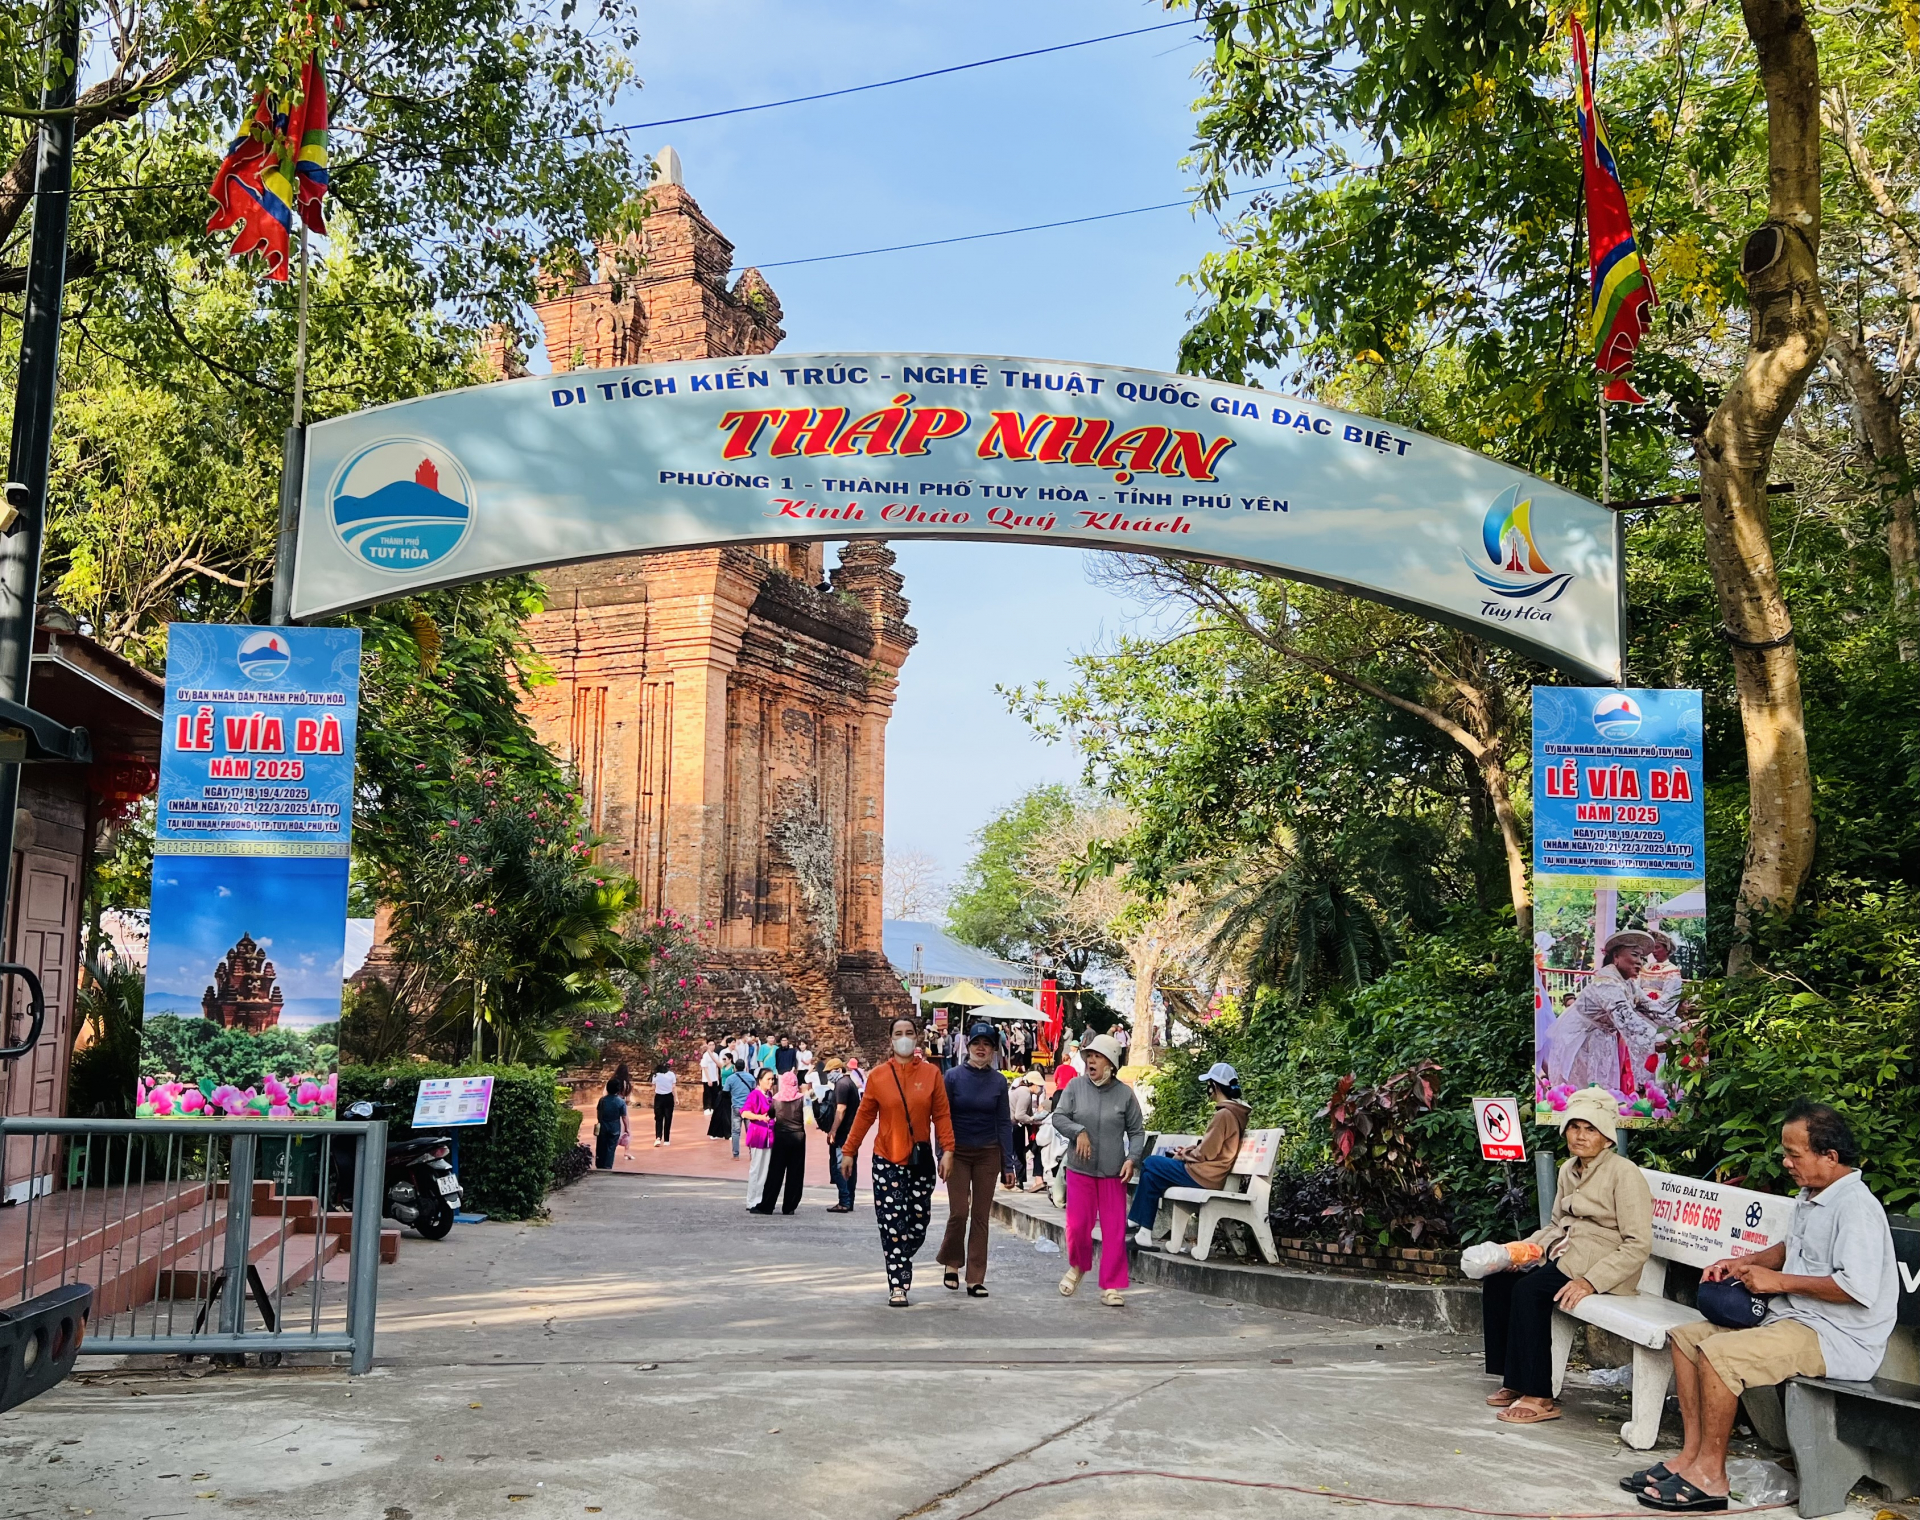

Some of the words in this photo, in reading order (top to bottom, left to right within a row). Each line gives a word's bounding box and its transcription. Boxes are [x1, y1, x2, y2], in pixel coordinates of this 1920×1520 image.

[551, 386, 587, 407] DI
[597, 377, 677, 401] TÍCH
[691, 365, 770, 392] KIẾN
[780, 363, 868, 385] TRÚC
[903, 364, 988, 388] NGHỆ
[1000, 371, 1104, 396] THUẬT
[1116, 383, 1200, 408] QUỐC
[1210, 397, 1260, 420] GIA
[1272, 408, 1332, 435] ĐẶC
[1343, 424, 1412, 456] BIỆT
[718, 393, 971, 460] THÁP
[977, 411, 1237, 485] NHẠN
[660, 471, 769, 488] PHƯỜNG
[781, 478, 794, 489] 1
[822, 477, 909, 494] THÀNH
[920, 480, 974, 496] PHỐ
[980, 485, 1029, 499] TUY
[1038, 486, 1088, 501] HÒA
[1115, 487, 1172, 506] TỈNH
[1183, 494, 1231, 509] PHÚ
[1241, 497, 1289, 512] YÊN
[762, 498, 868, 520] Kính
[880, 503, 972, 524] Chào
[986, 507, 1060, 531] Quý
[1070, 510, 1193, 534] Khách
[380, 537, 403, 546] THÀNH
[369, 547, 396, 559] TUY
[401, 546, 429, 559] HÒA
[1481, 600, 1512, 621] Tuy
[1514, 606, 1552, 621] Hòa
[192, 690, 209, 700] BAN
[212, 690, 235, 700] NHÂN
[237, 691, 254, 701] DÂN
[257, 692, 286, 702] THÀNH
[288, 691, 306, 703] PHỐ
[308, 693, 324, 703] TUY
[177, 706, 213, 749] LỄ
[225, 712, 284, 752] VÍA
[296, 714, 341, 753] BÀ
[1556, 745, 1572, 753] BAN
[1574, 744, 1594, 754] NHÂN
[1596, 745, 1612, 755] DÂN
[1614, 745, 1638, 755] THÀNH
[1641, 744, 1656, 756] PHỐ
[1658, 747, 1673, 757] TUY
[210, 757, 250, 777] NĂM
[256, 760, 302, 779] 2025
[1547, 759, 1577, 796] LỄ
[1587, 765, 1640, 798] VÍA
[1651, 766, 1690, 800] BÀ
[204, 785, 229, 798] NGÀY
[259, 788, 308, 799] 19/4/2025
[201, 800, 226, 812] NGÀY
[258, 803, 308, 814] 22/3/2025
[1577, 803, 1611, 821] NĂM
[1617, 806, 1658, 823] 2025
[272, 821, 287, 831] TUY
[1573, 828, 1595, 838] NGÀY
[1621, 830, 1664, 841] 19/4/2025
[1571, 840, 1593, 851] NGÀY
[1621, 843, 1665, 853] 22/3/2025
[1635, 860, 1648, 869] TUY
[1489, 1147, 1498, 1155] No
[1499, 1148, 1516, 1157] Dogs
[1699, 1189, 1719, 1202] TAXI
[1673, 1199, 1681, 1222] 3
[1682, 1201, 1702, 1227] 666
[1702, 1205, 1722, 1232] 666
[1730, 1226, 1741, 1239] SAO
